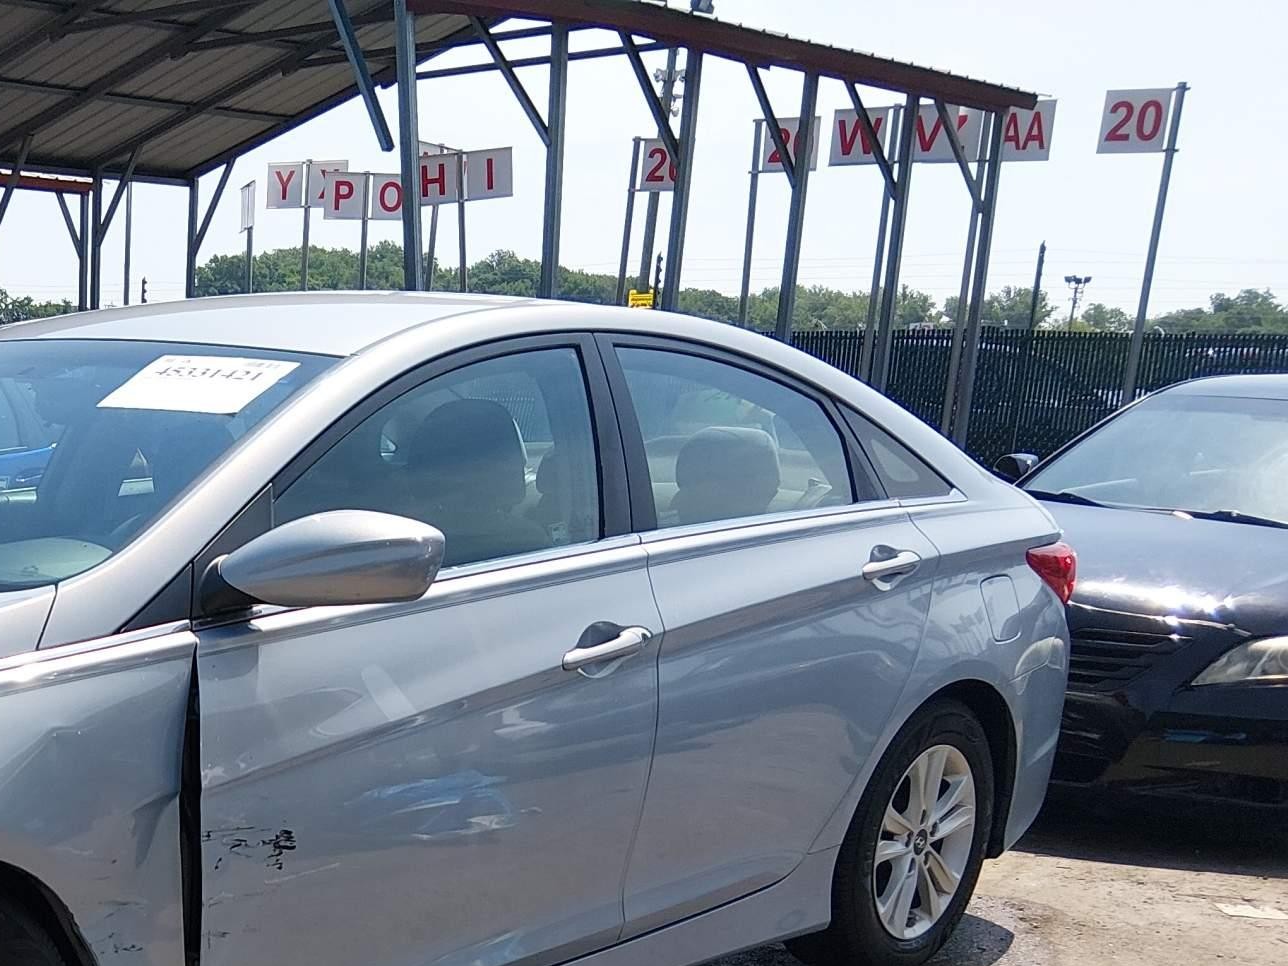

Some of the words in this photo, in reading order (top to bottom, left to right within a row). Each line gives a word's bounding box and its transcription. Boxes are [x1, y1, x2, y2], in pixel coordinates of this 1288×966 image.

[838, 117, 883, 156] W
[1004, 111, 1045, 150] AA
[1104, 100, 1163, 142] 20
[275, 170, 296, 200] Y
[333, 180, 354, 211] P
[421, 163, 446, 197] H
[486, 158, 493, 190] I
[154, 366, 264, 381] 45331421
